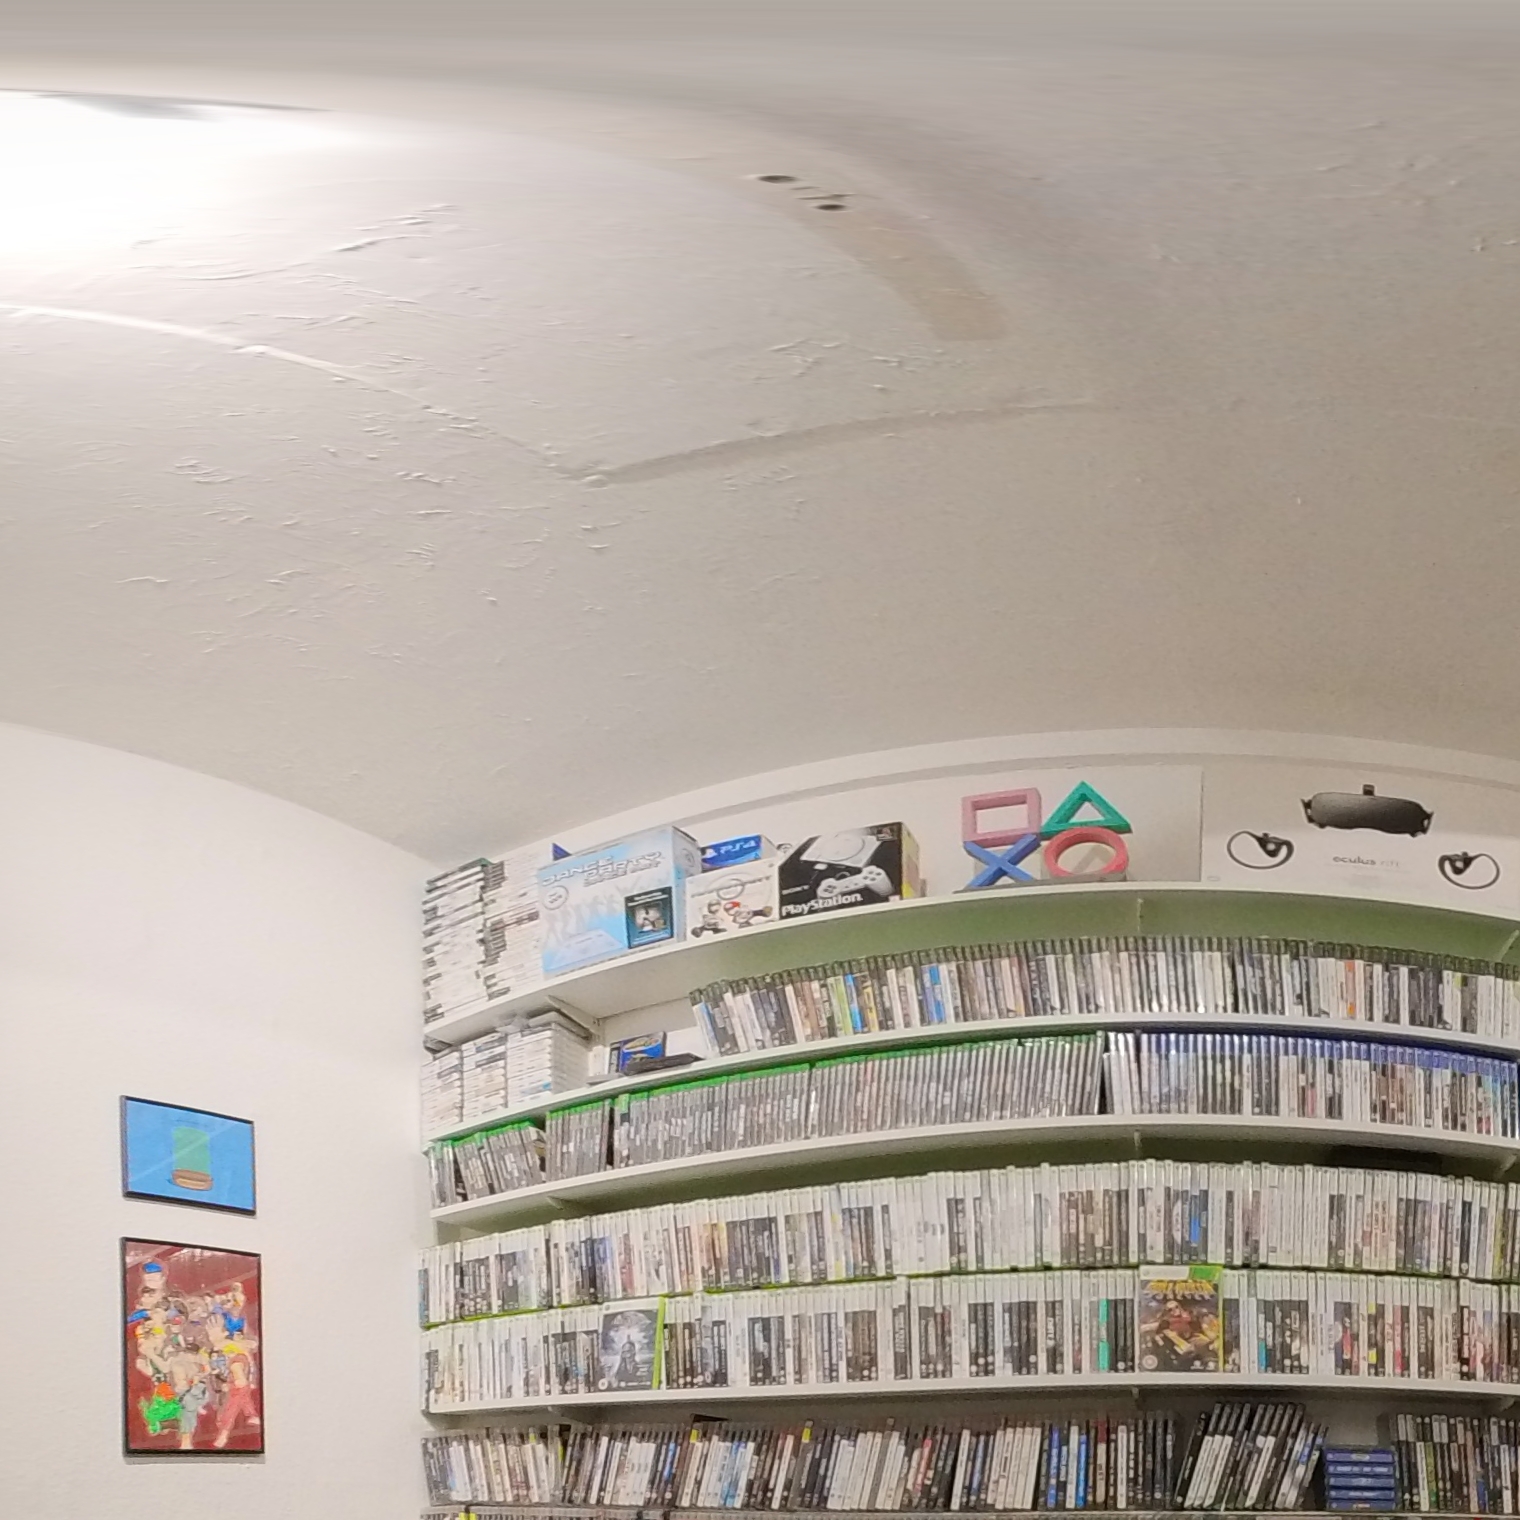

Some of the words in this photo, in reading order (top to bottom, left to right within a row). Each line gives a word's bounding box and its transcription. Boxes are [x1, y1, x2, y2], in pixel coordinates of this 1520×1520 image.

[720, 839, 758, 855] PS4
[1333, 855, 1376, 866] oculus
[781, 892, 863, 917] PlayStation
